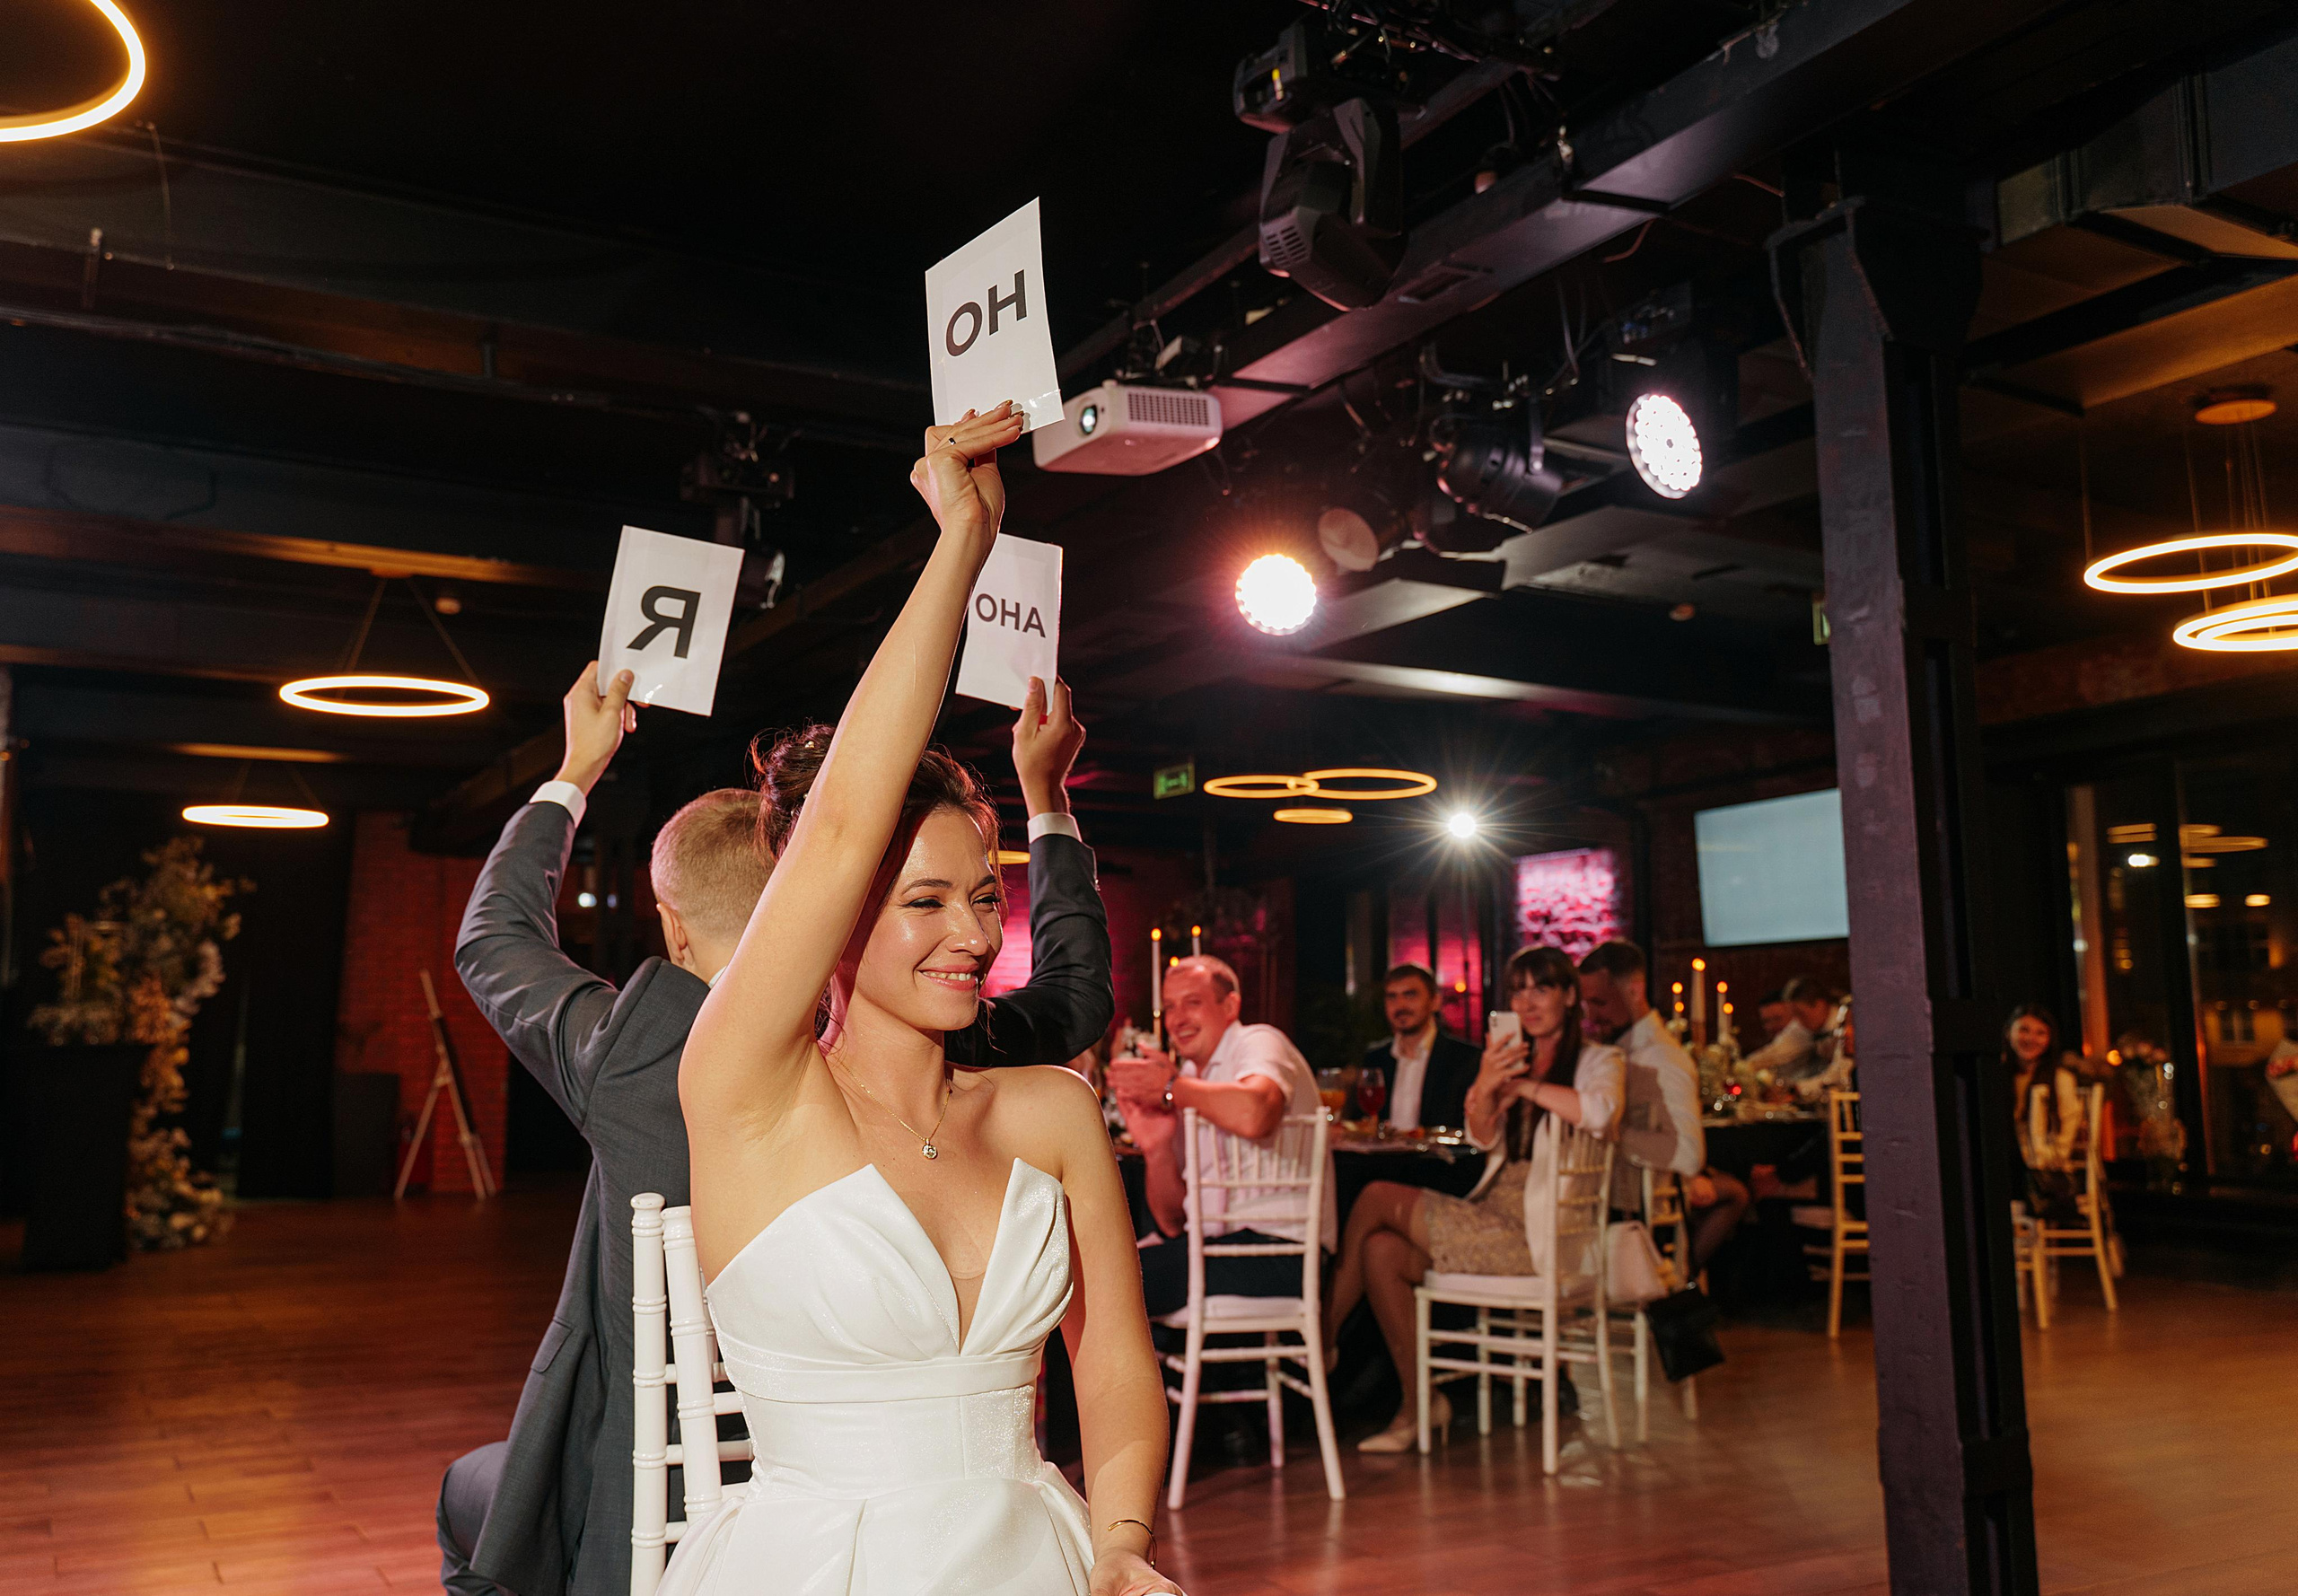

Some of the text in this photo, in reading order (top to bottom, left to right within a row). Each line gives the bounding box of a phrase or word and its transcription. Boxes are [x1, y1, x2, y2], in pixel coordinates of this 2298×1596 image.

[946, 269, 1027, 356] ОН
[626, 586, 701, 659] Я
[976, 593, 1046, 638] ОНА
